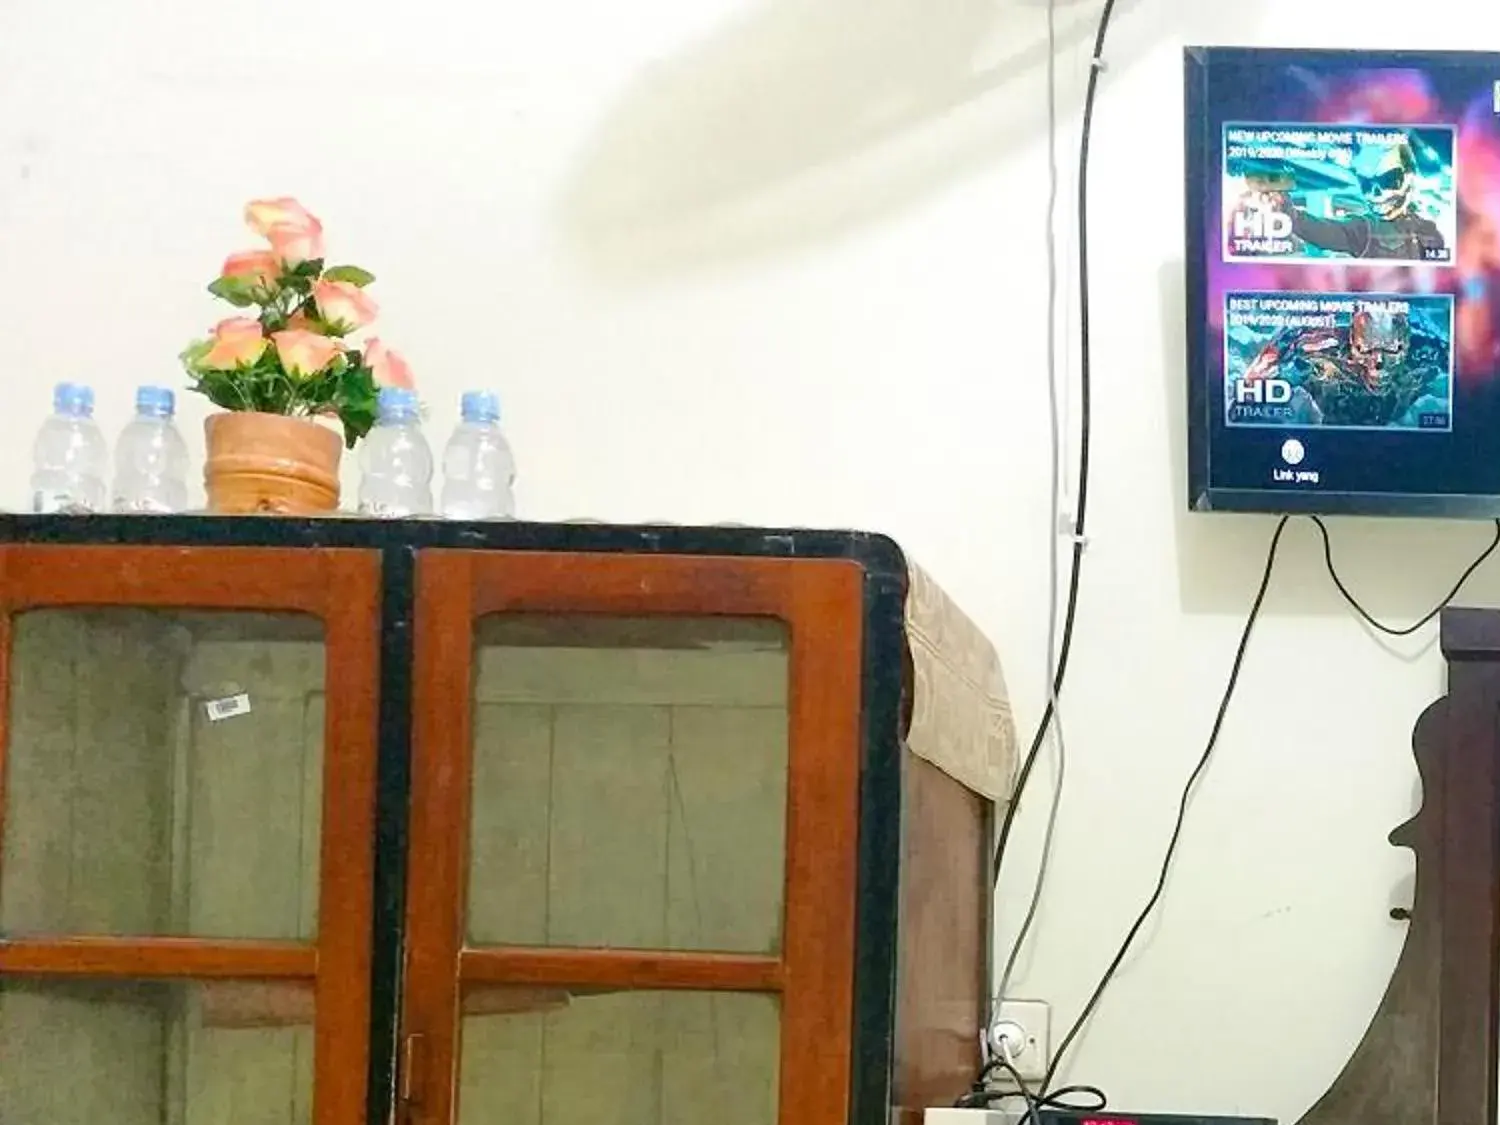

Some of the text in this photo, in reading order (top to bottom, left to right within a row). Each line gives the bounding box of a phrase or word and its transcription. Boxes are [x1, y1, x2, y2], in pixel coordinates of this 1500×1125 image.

[1228, 130, 1409, 145] NEW UPCOMING MOVIE TRAILERS
[1230, 299, 1410, 314] BEST UPCOMING MOVIE TRAILERS
[1235, 379, 1292, 403] HD
[1235, 405, 1293, 418] TRAILER
[1273, 467, 1295, 481] Link
